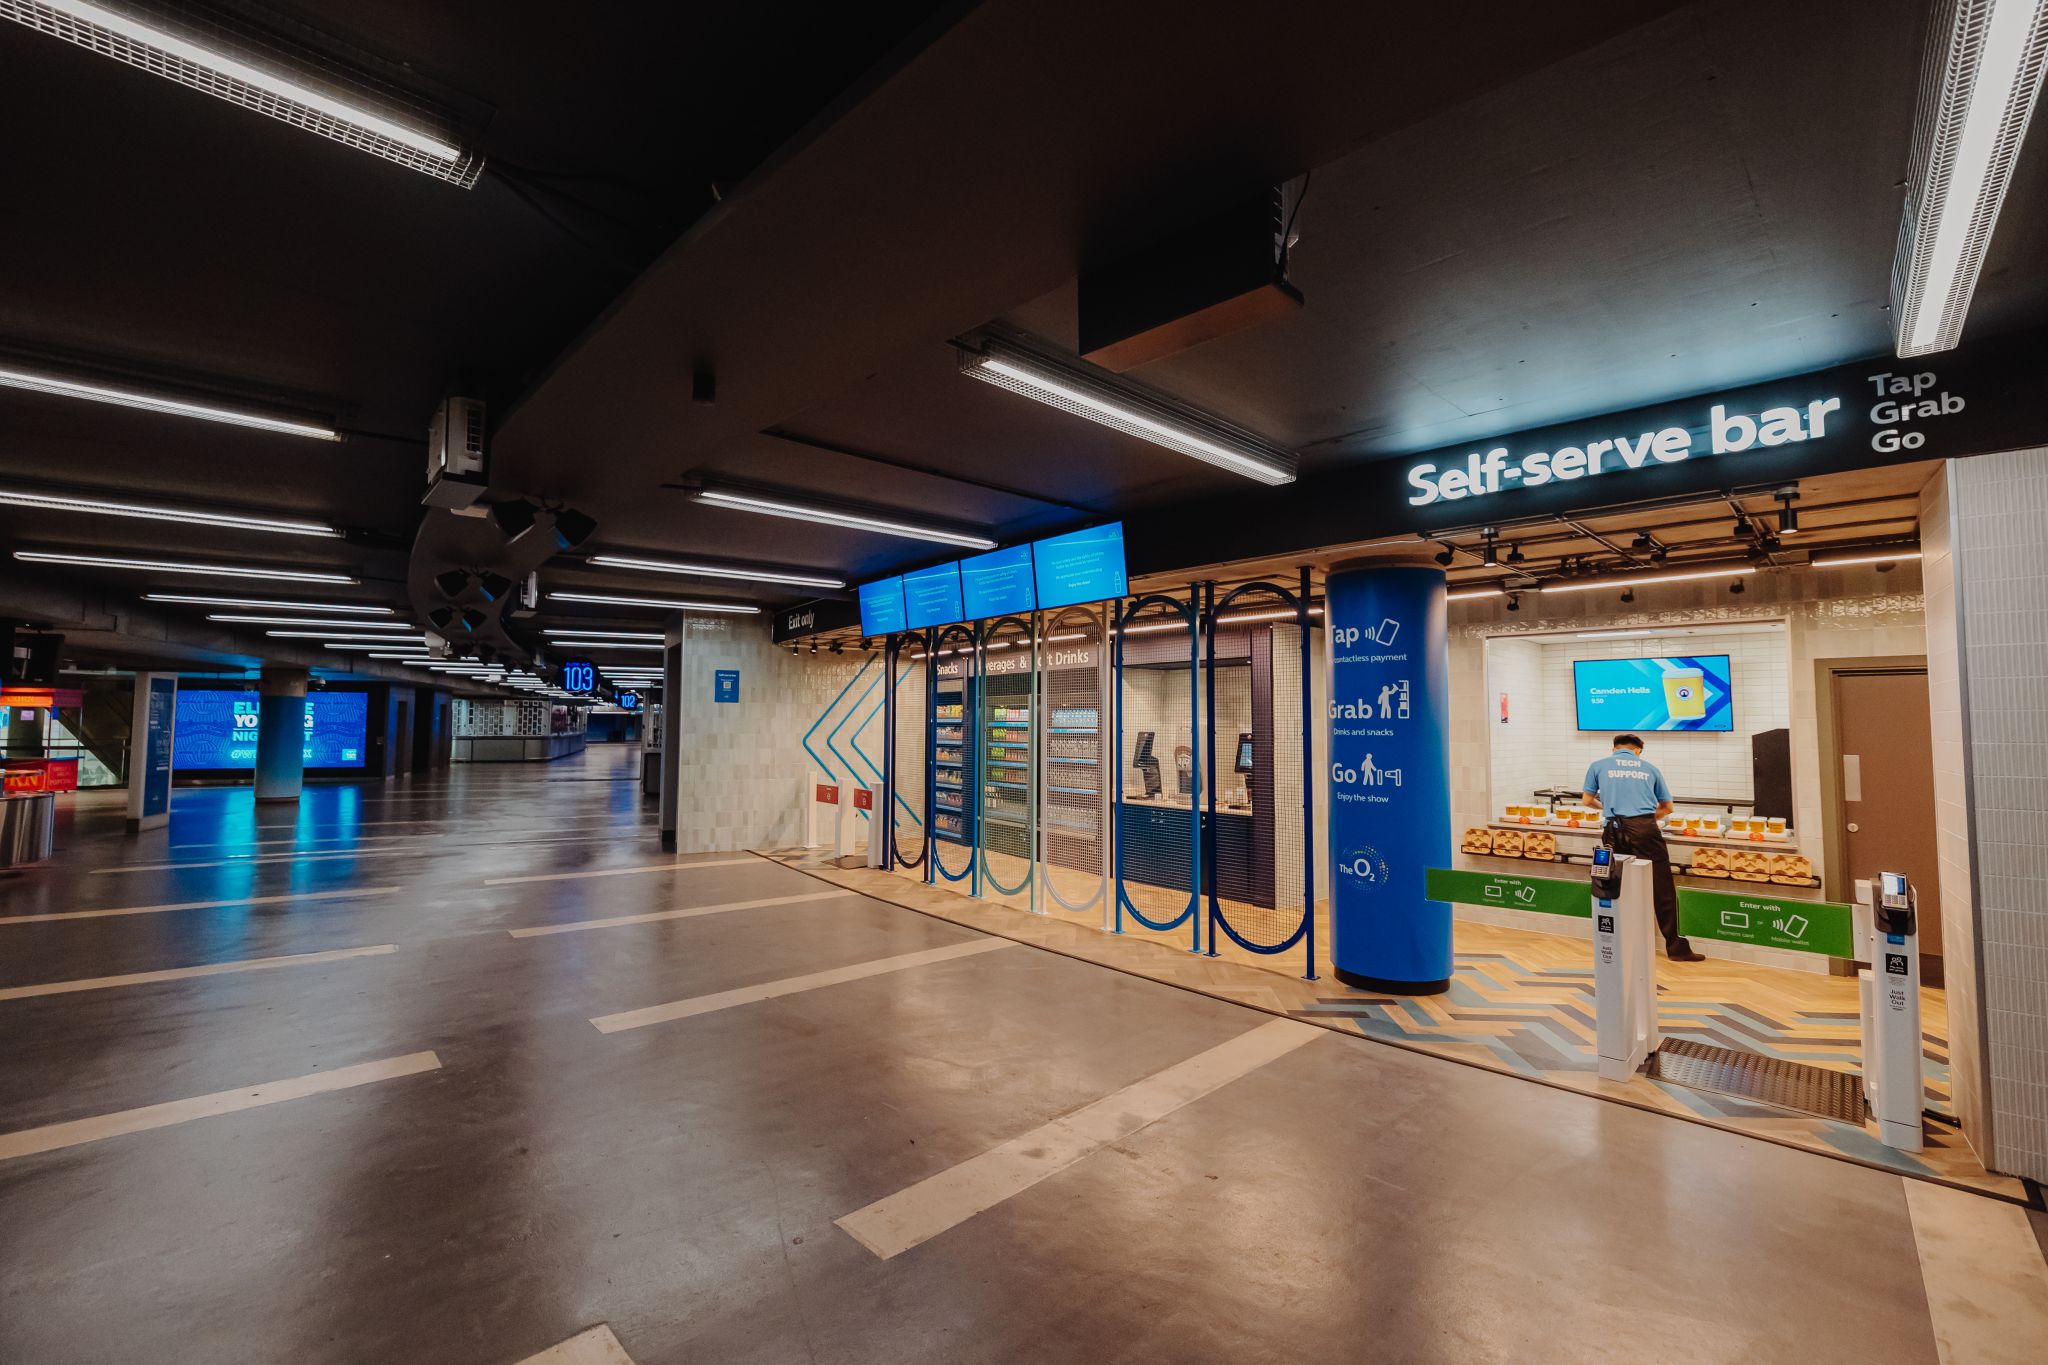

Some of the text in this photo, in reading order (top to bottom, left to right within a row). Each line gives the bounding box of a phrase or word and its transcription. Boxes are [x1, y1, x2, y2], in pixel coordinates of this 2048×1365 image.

[1868, 372, 1936, 397] Tap
[1870, 391, 1965, 424] Grab
[1871, 429, 1925, 453] Go
[1407, 396, 1842, 506] Self-serve bar
[788, 609, 814, 630] Exit only
[1019, 655, 1027, 669] &
[1055, 649, 1089, 665] Drinks
[1370, 653, 1408, 663] payment
[937, 661, 958, 675] Snacks
[563, 666, 593, 691] 103
[1590, 687, 1626, 695] Camden
[619, 694, 635, 708] 102
[1328, 698, 1373, 719] Grab
[1333, 727, 1394, 736] Drinks and snacks
[1615, 758, 1641, 768] TECH
[1332, 762, 1357, 784] Go
[1607, 769, 1650, 781] SUPPORT
[1337, 791, 1389, 803] Enjoy the show
[1339, 863, 1354, 875] The
[1739, 901, 1781, 912] Enter with
